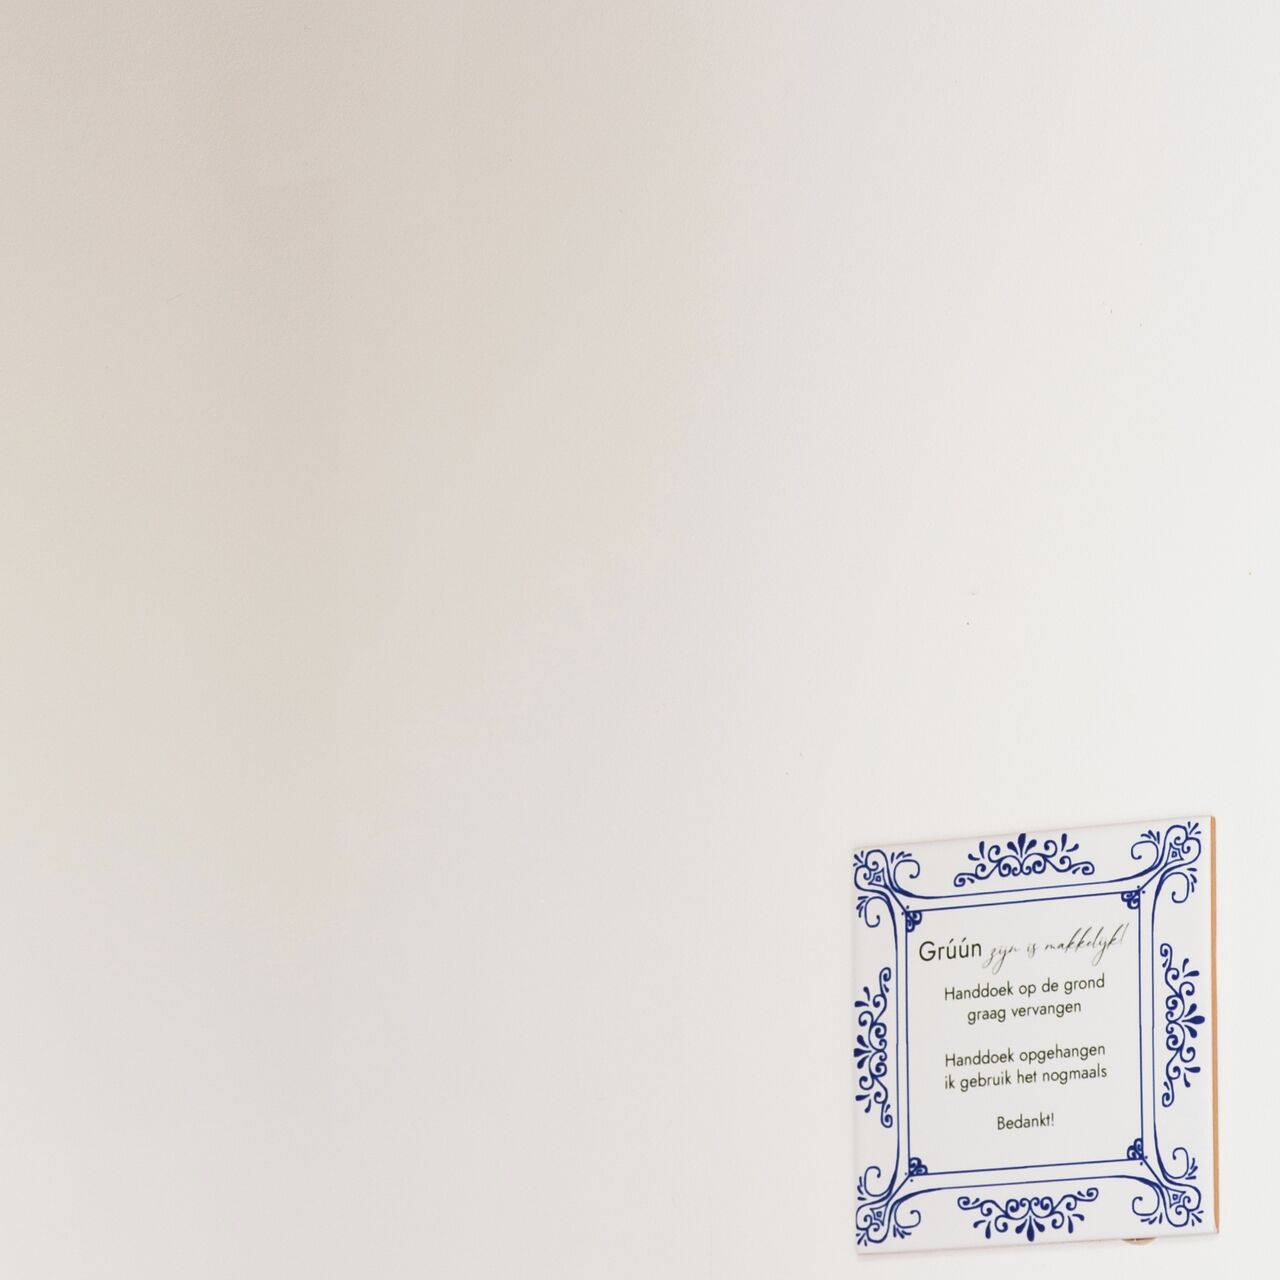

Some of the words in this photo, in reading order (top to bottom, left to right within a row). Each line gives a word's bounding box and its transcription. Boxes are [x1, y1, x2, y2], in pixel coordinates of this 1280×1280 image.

[919, 937, 982, 962] Grúún
[944, 981, 1014, 1001] Handdoek
[1018, 985, 1037, 997] op
[1041, 977, 1059, 994] de
[1064, 972, 1105, 995] grond
[967, 1008, 1006, 1025] graag
[1011, 1001, 1082, 1018] vervangen
[945, 1047, 1014, 1067] Handdoek
[1019, 1043, 1106, 1065] opgehangen
[944, 1074, 955, 1090] ik
[960, 1069, 1012, 1092] gebruik
[1017, 1069, 1037, 1084] het
[1042, 1063, 1108, 1085] nogmaals
[997, 1112, 1055, 1131] Bedankt!
